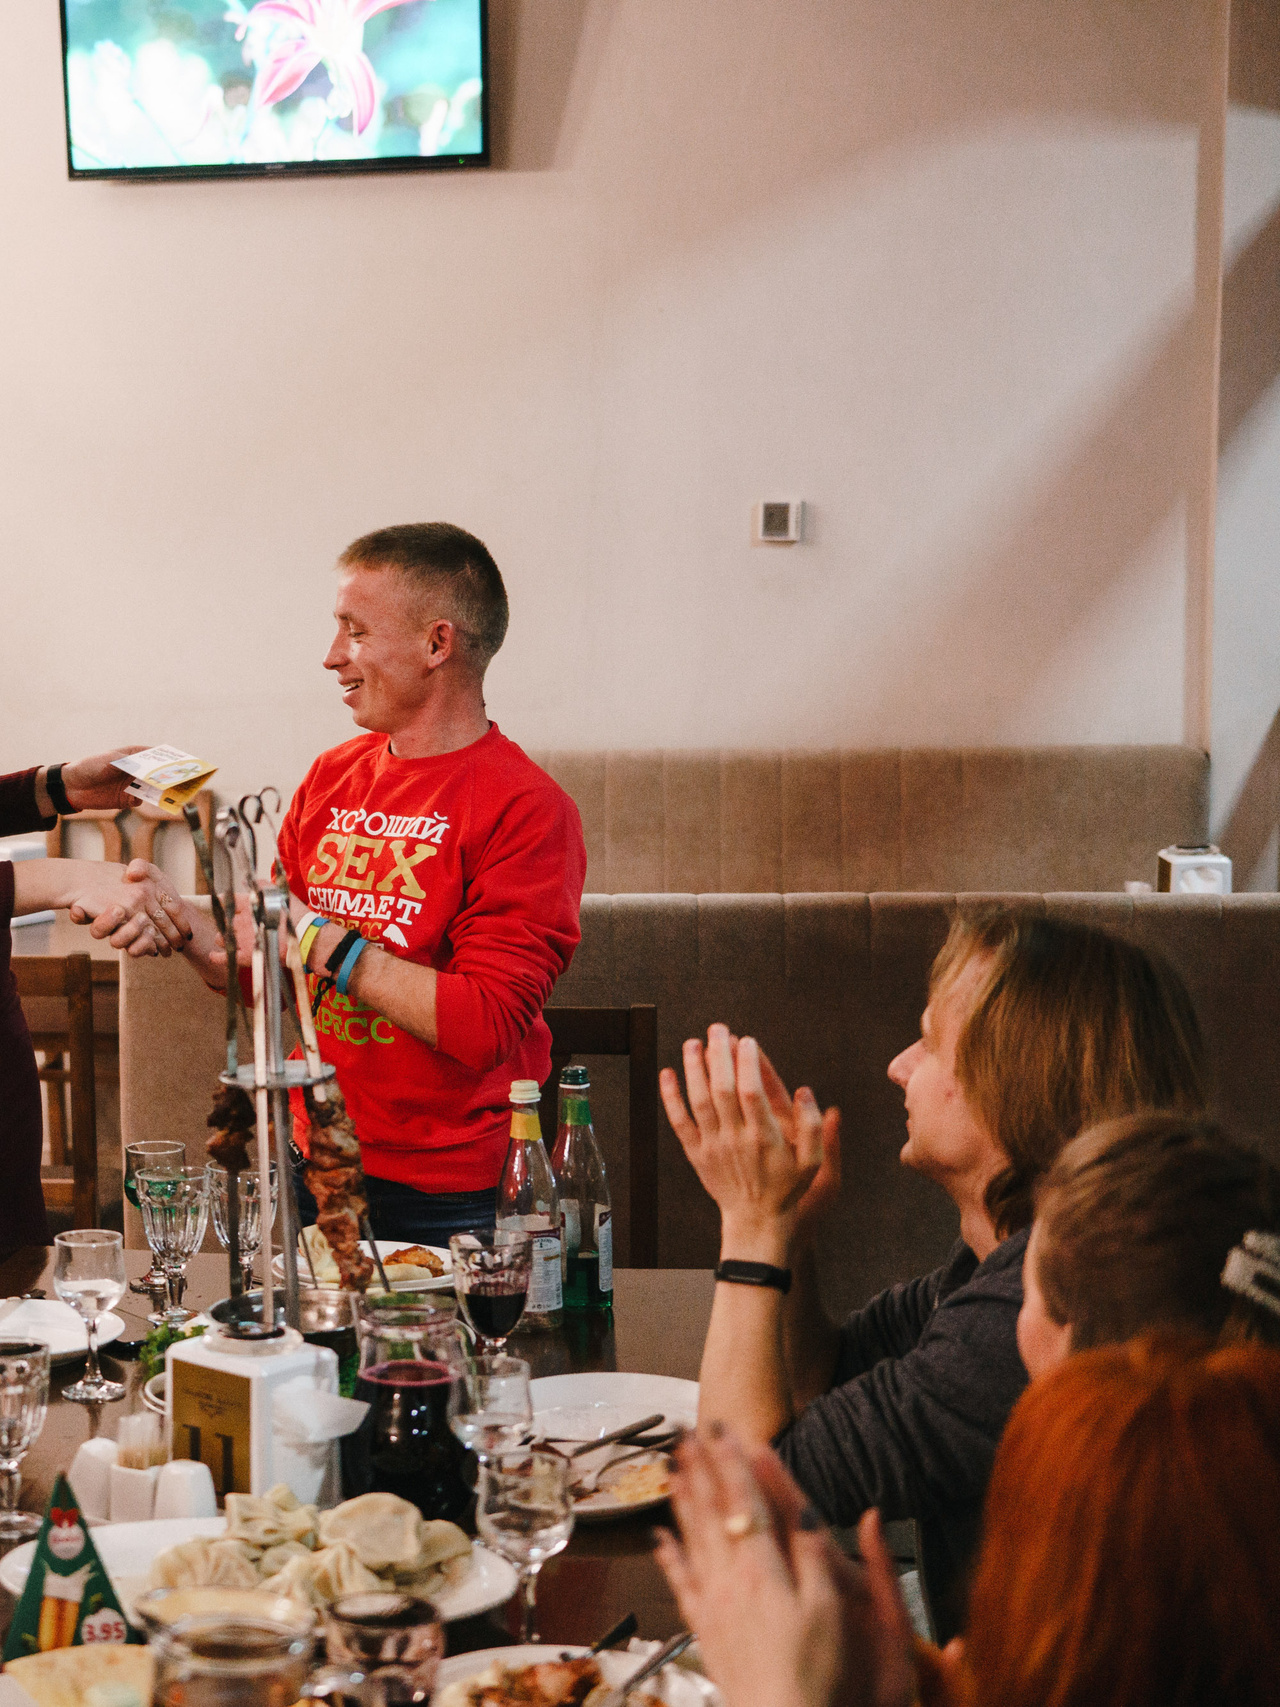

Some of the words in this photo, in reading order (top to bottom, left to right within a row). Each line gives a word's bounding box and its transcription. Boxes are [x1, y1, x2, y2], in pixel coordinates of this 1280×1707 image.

[307, 832, 438, 900] SEX
[307, 886, 423, 926] СНИМАЕТ
[315, 1005, 396, 1045] РЕСС
